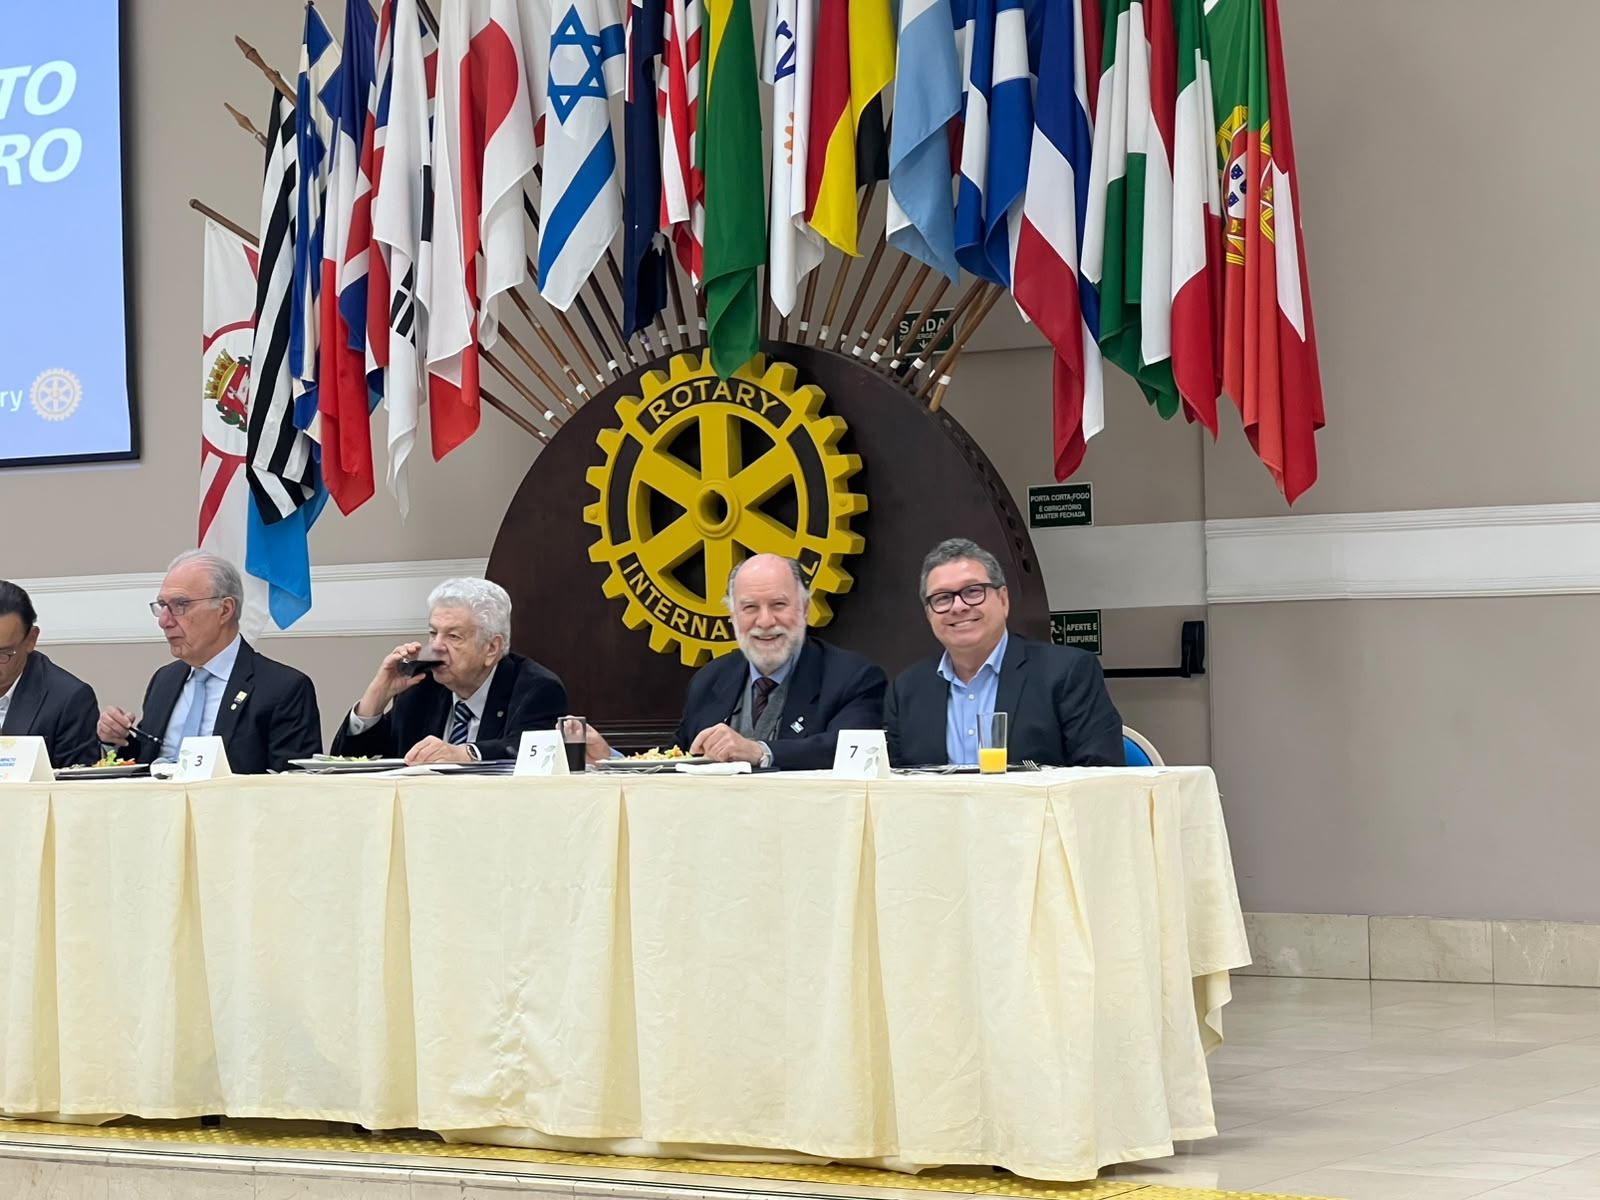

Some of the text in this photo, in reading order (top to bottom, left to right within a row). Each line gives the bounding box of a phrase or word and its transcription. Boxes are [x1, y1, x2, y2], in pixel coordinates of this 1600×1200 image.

[648, 380, 779, 424] ROTARY
[1066, 622, 1097, 631] APERTE E
[1066, 635, 1098, 643] EMPURRE
[529, 744, 538, 758] 5
[849, 745, 859, 759] 7
[194, 754, 204, 767] 3
